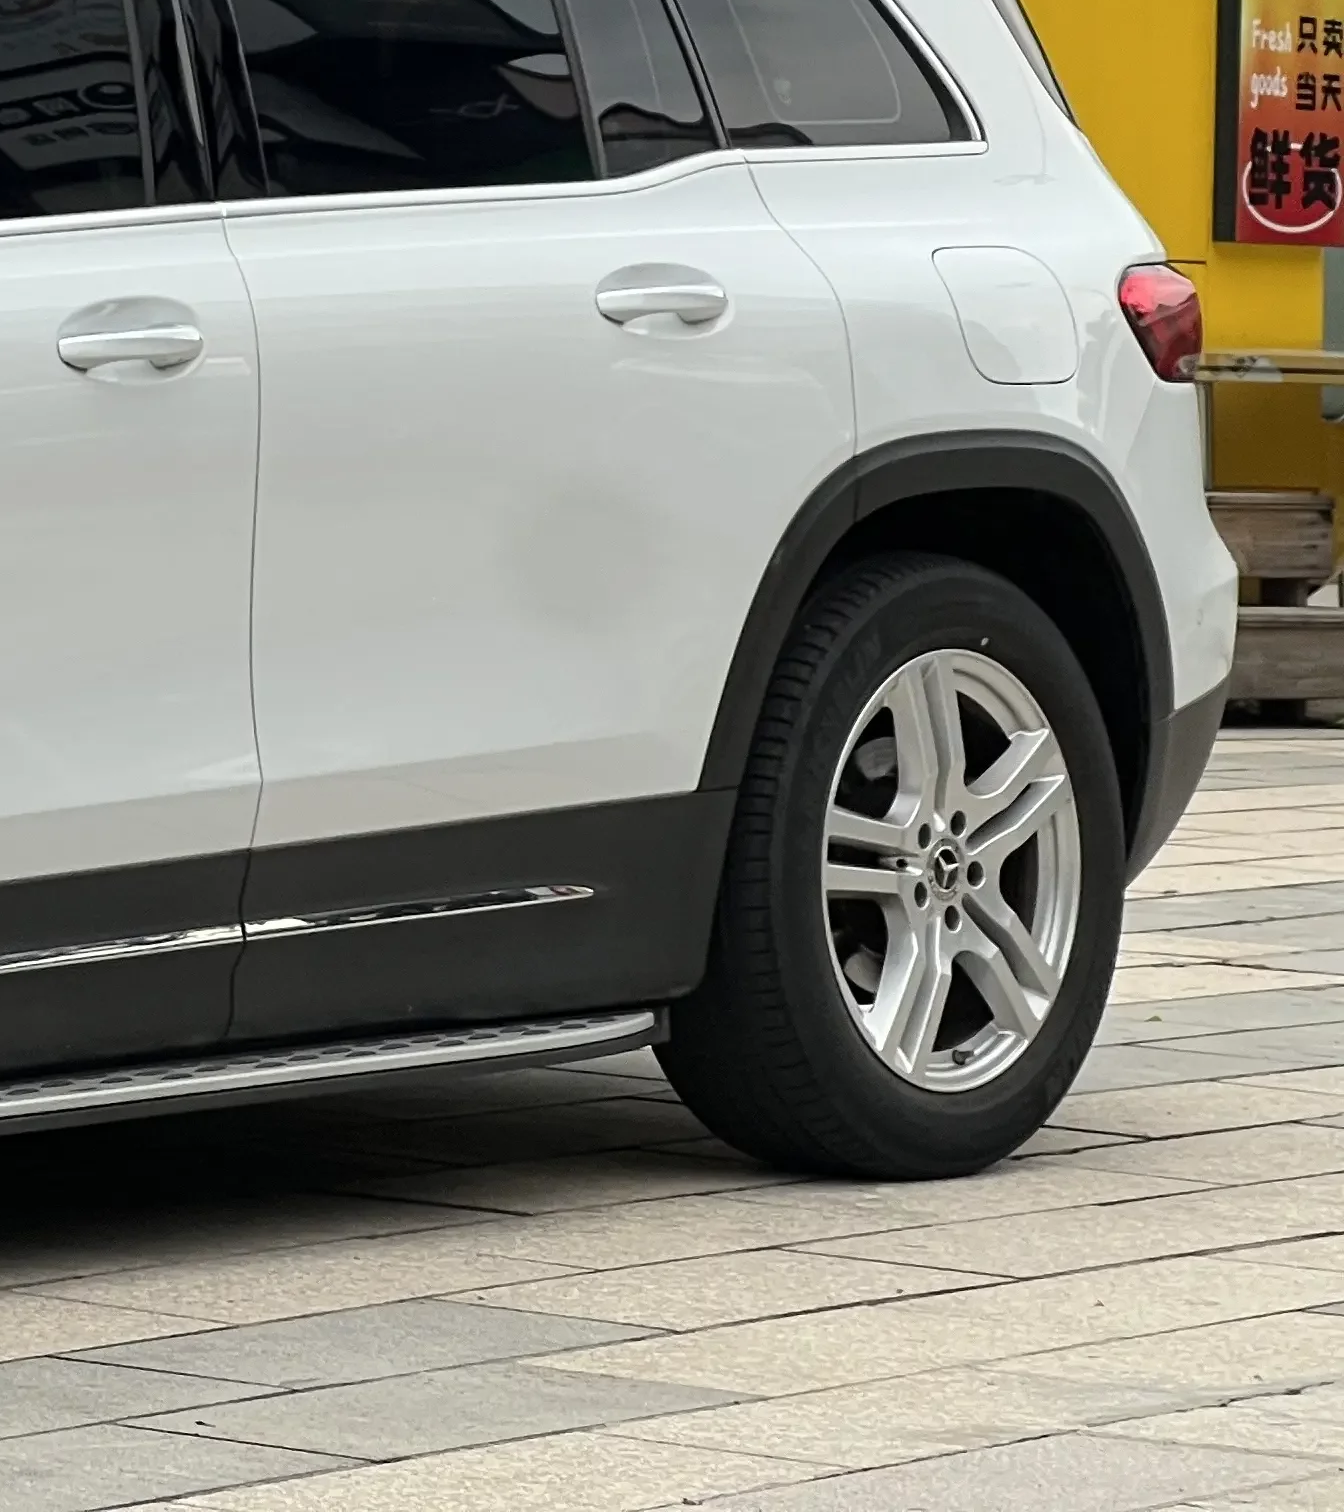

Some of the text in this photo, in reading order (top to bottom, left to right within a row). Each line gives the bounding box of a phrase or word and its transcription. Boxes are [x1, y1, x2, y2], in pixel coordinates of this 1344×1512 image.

[1251, 18, 1292, 53] Fresh
[1250, 65, 1289, 109] goods
[1296, 71, 1342, 112] 当天
[1248, 127, 1342, 210] 鲜货
